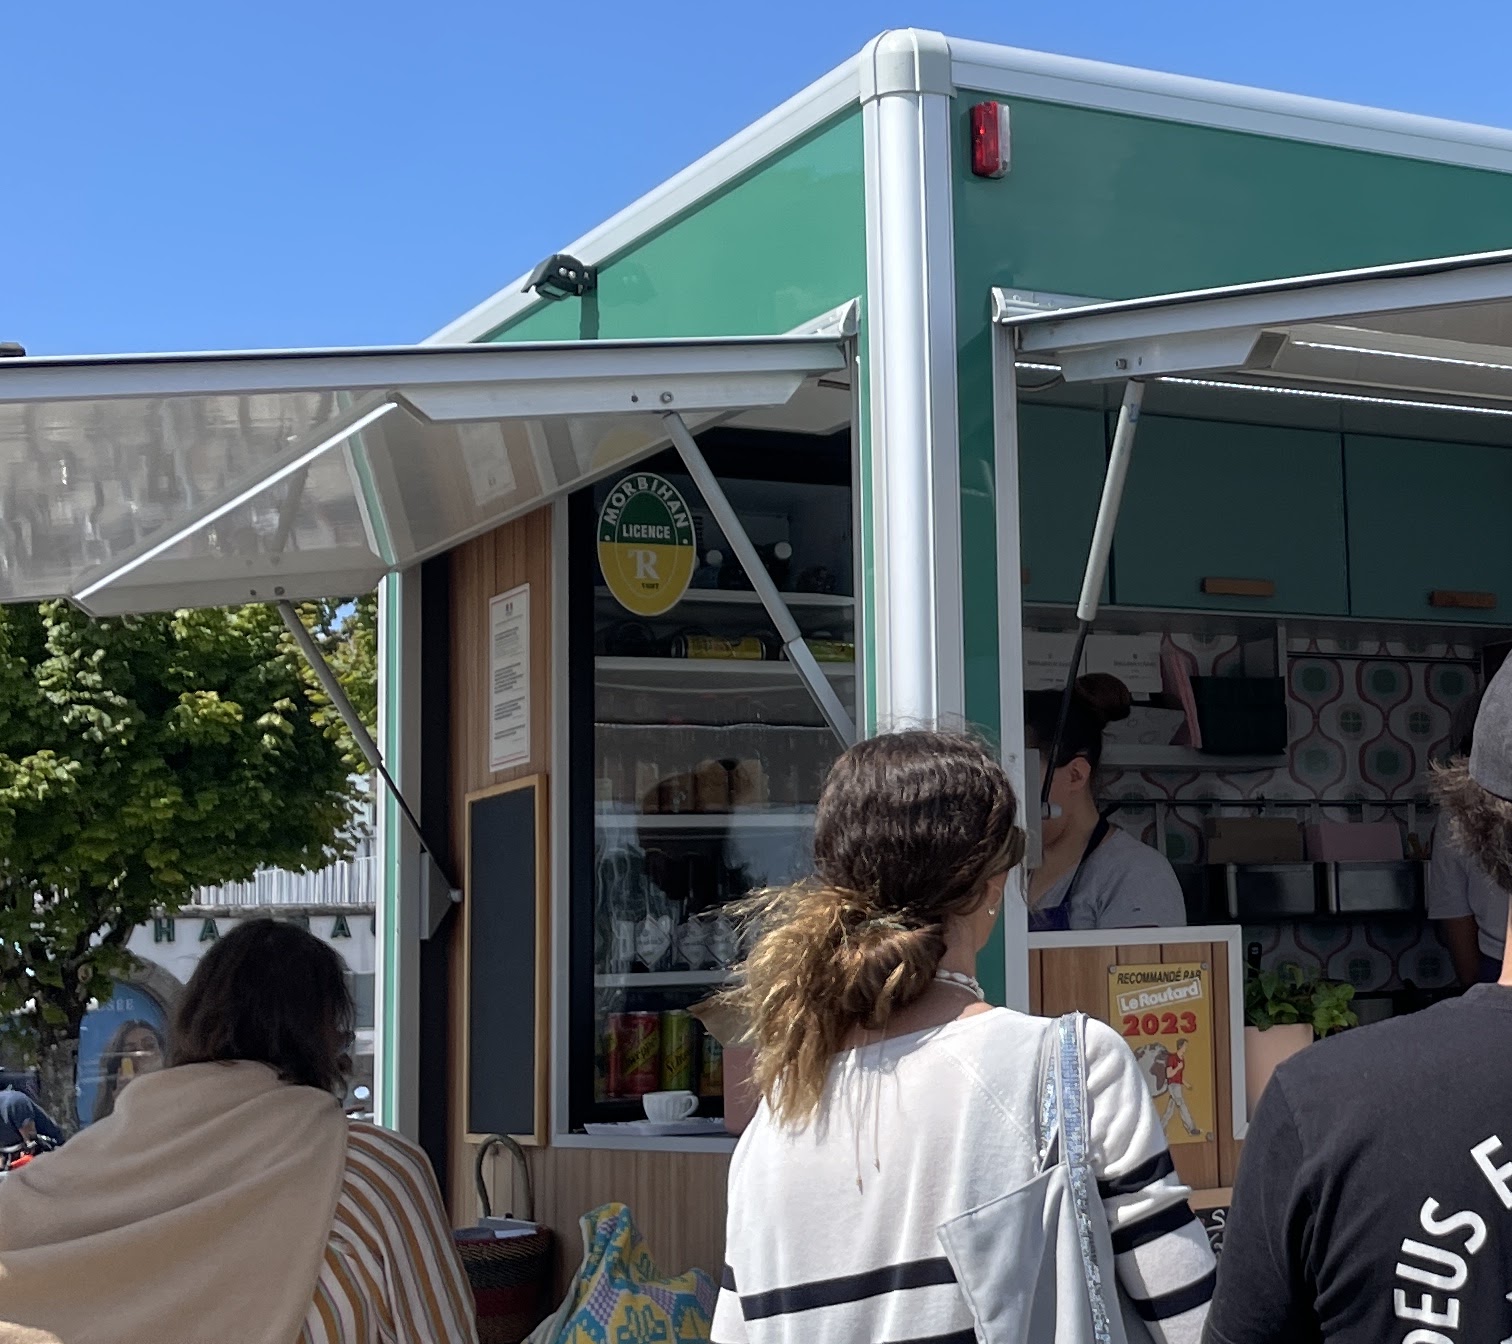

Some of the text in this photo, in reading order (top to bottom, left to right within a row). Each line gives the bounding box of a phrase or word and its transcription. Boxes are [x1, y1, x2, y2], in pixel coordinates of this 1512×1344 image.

[603, 476, 690, 529] MORBIHAN
[622, 523, 671, 540] LICENCE
[1116, 966, 1182, 985] RECOMMANDÉ
[1139, 981, 1199, 1007] Routard
[1122, 1011, 1197, 1036] 2023
